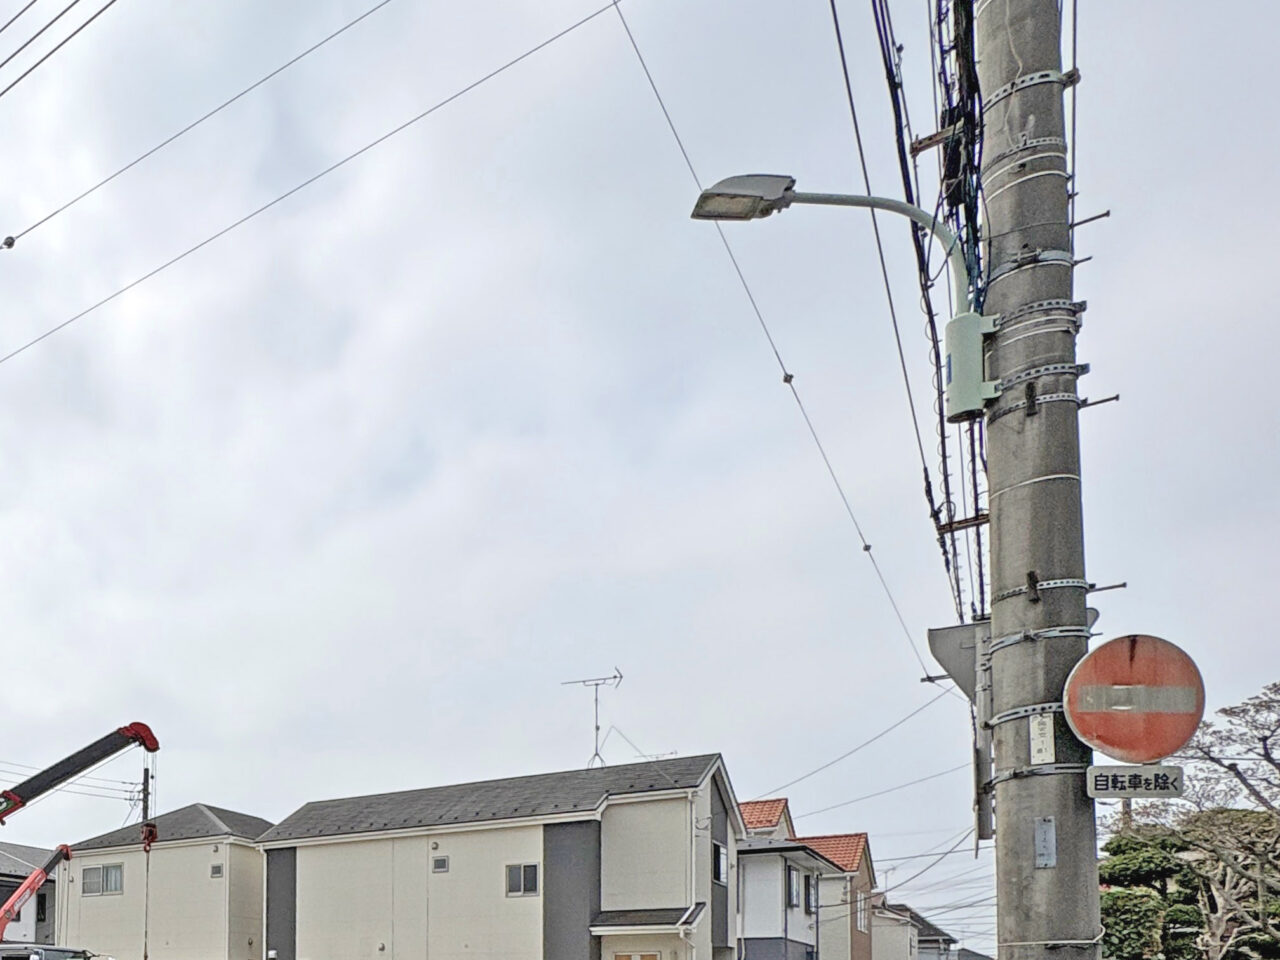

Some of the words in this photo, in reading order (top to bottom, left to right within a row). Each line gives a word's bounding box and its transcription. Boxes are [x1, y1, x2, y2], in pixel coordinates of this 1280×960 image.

[1094, 773, 1178, 791] 自転車を除く
